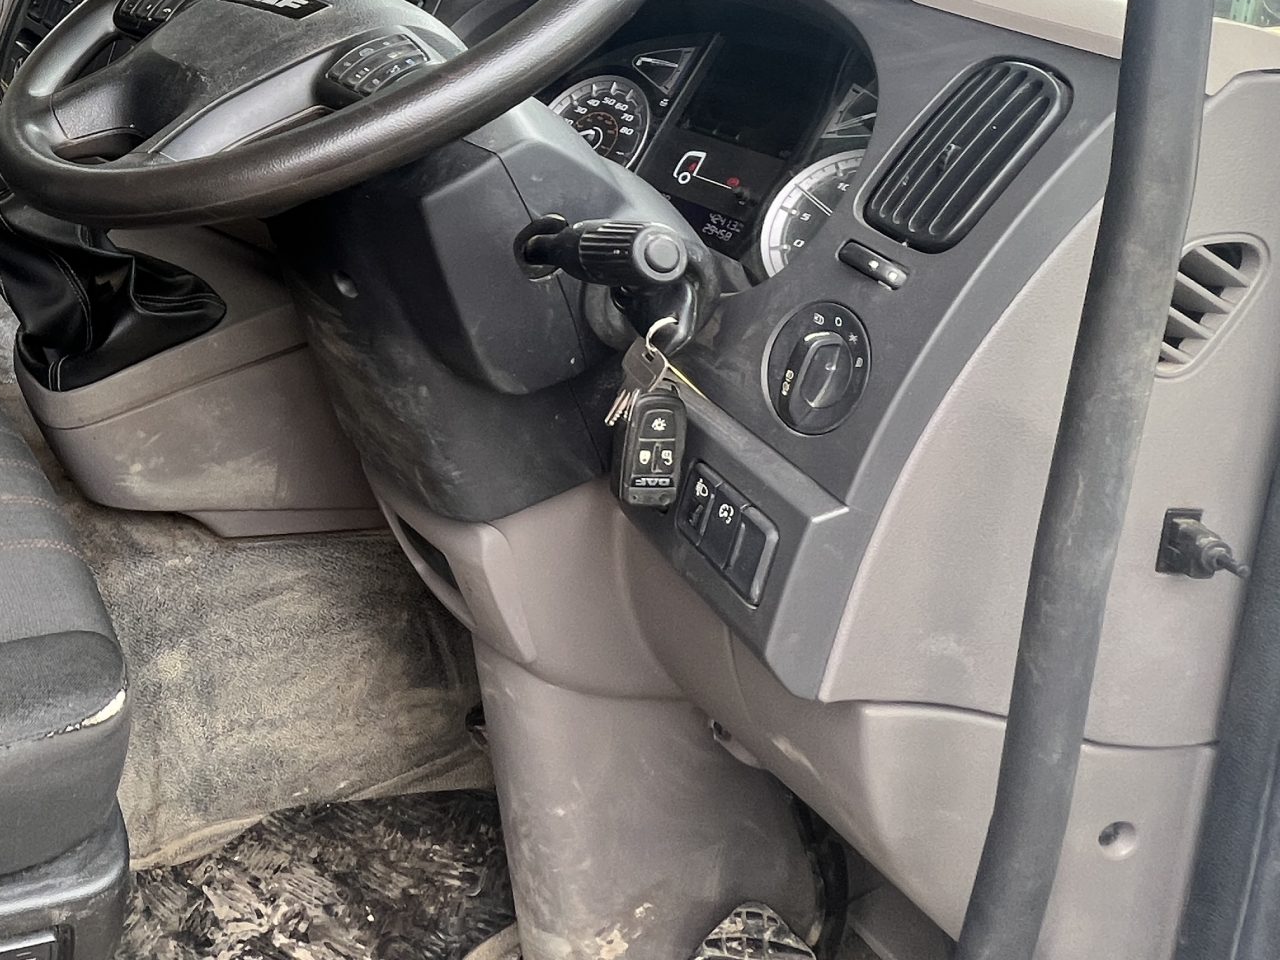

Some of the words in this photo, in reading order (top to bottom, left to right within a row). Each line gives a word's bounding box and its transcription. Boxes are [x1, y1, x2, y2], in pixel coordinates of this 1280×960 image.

[586, 98, 600, 107] 40
[601, 96, 616, 106] 50
[574, 105, 588, 115] 30
[614, 102, 629, 111] 60
[620, 112, 634, 122] 70
[619, 126, 634, 136] 80
[793, 239, 805, 248] 0
[635, 477, 671, 487] DAF
